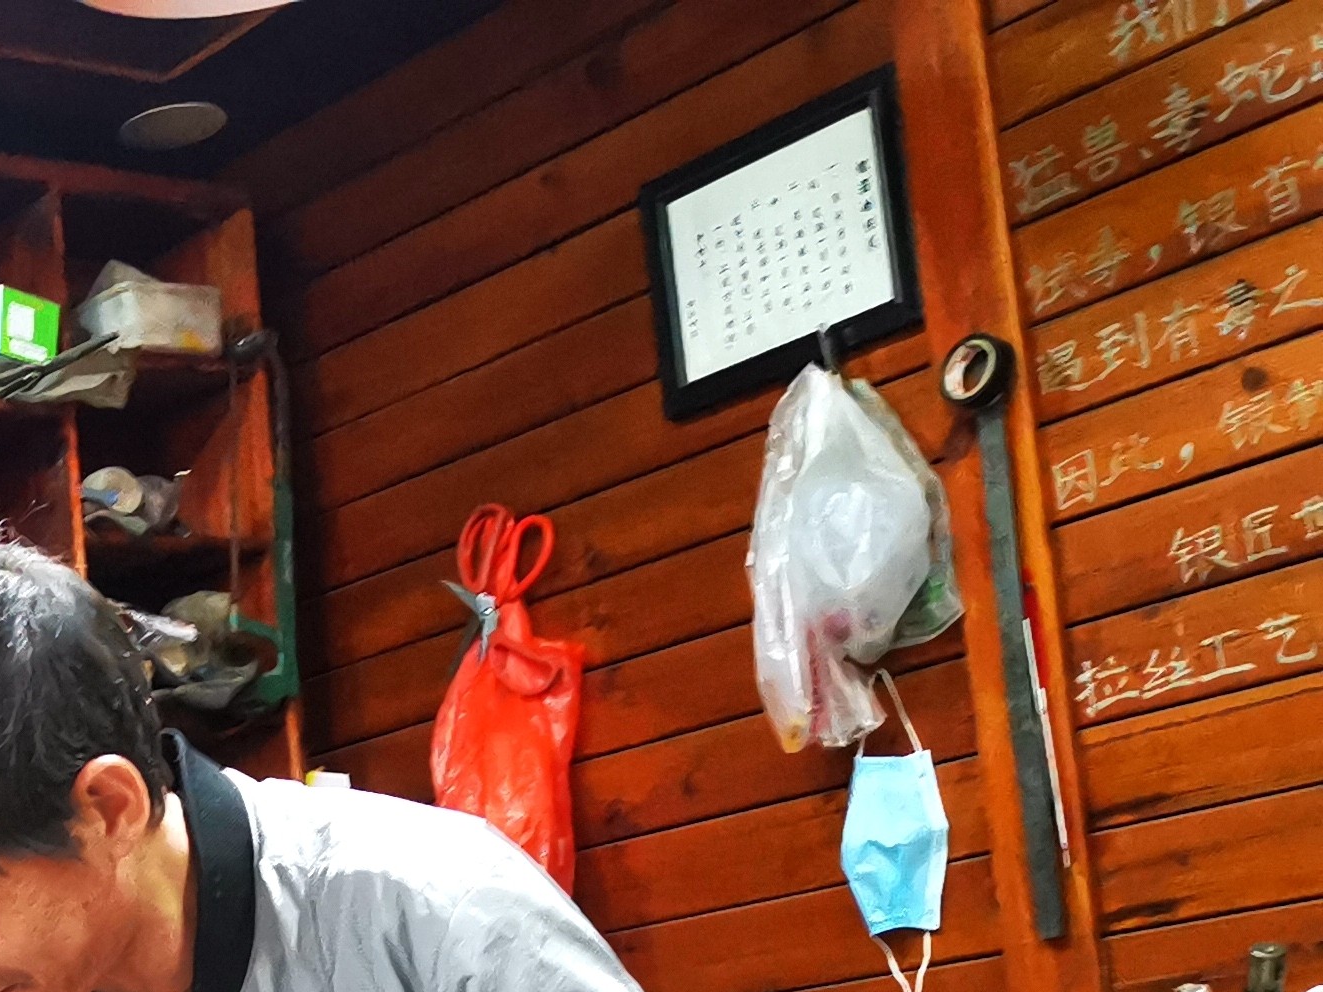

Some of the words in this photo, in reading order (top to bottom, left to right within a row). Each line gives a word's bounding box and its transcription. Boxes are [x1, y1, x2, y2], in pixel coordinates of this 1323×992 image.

[1007, 34, 1323, 215] 猛兽、毒蛇
[1024, 147, 1323, 314] 试毒，银首
[1073, 611, 1318, 718] 拉丝工艺
